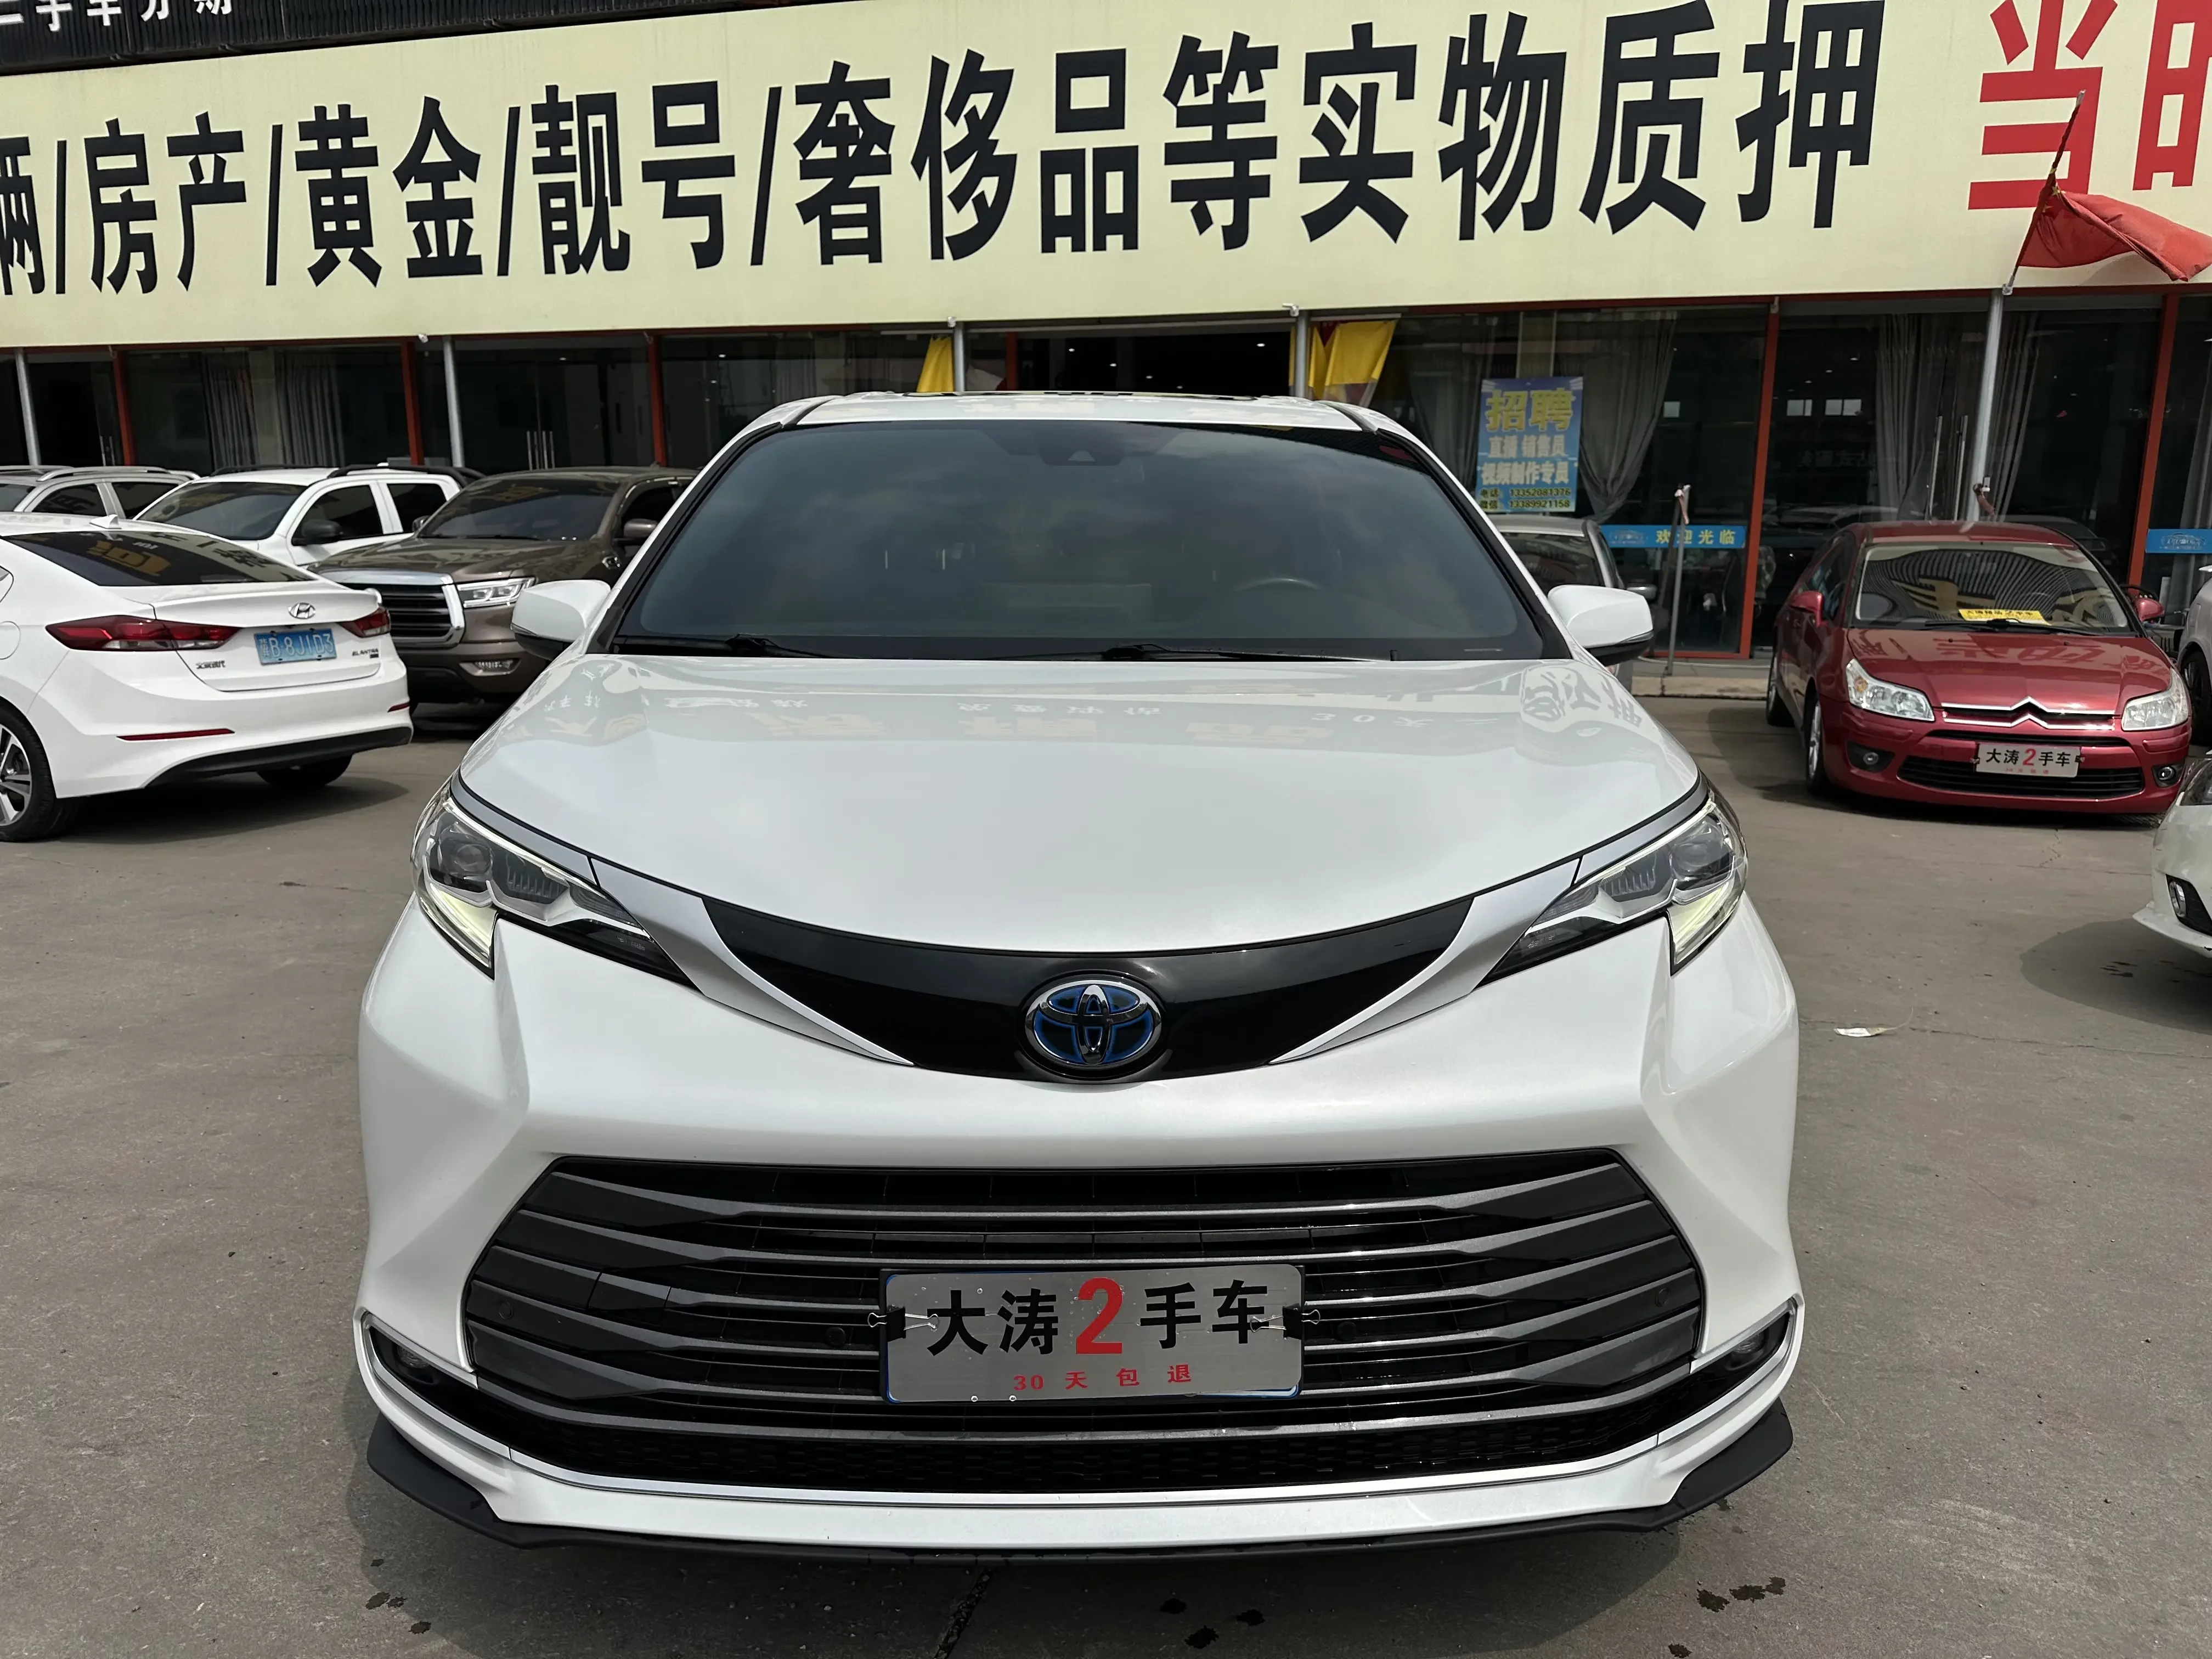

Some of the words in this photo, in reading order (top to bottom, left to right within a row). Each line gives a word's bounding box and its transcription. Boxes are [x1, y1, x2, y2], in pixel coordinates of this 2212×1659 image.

[1485, 387, 1573, 432] 招聘
[1487, 435, 1518, 458] 直播
[1521, 434, 1568, 458] 销售员
[1481, 460, 1570, 486] 视频制作专员
[1655, 528, 1736, 544] 欢迎光临
[1985, 747, 2071, 767] 大涛2手车
[926, 1277, 1270, 1357] 大涛2手车
[1013, 1364, 1193, 1391] 30天包退
